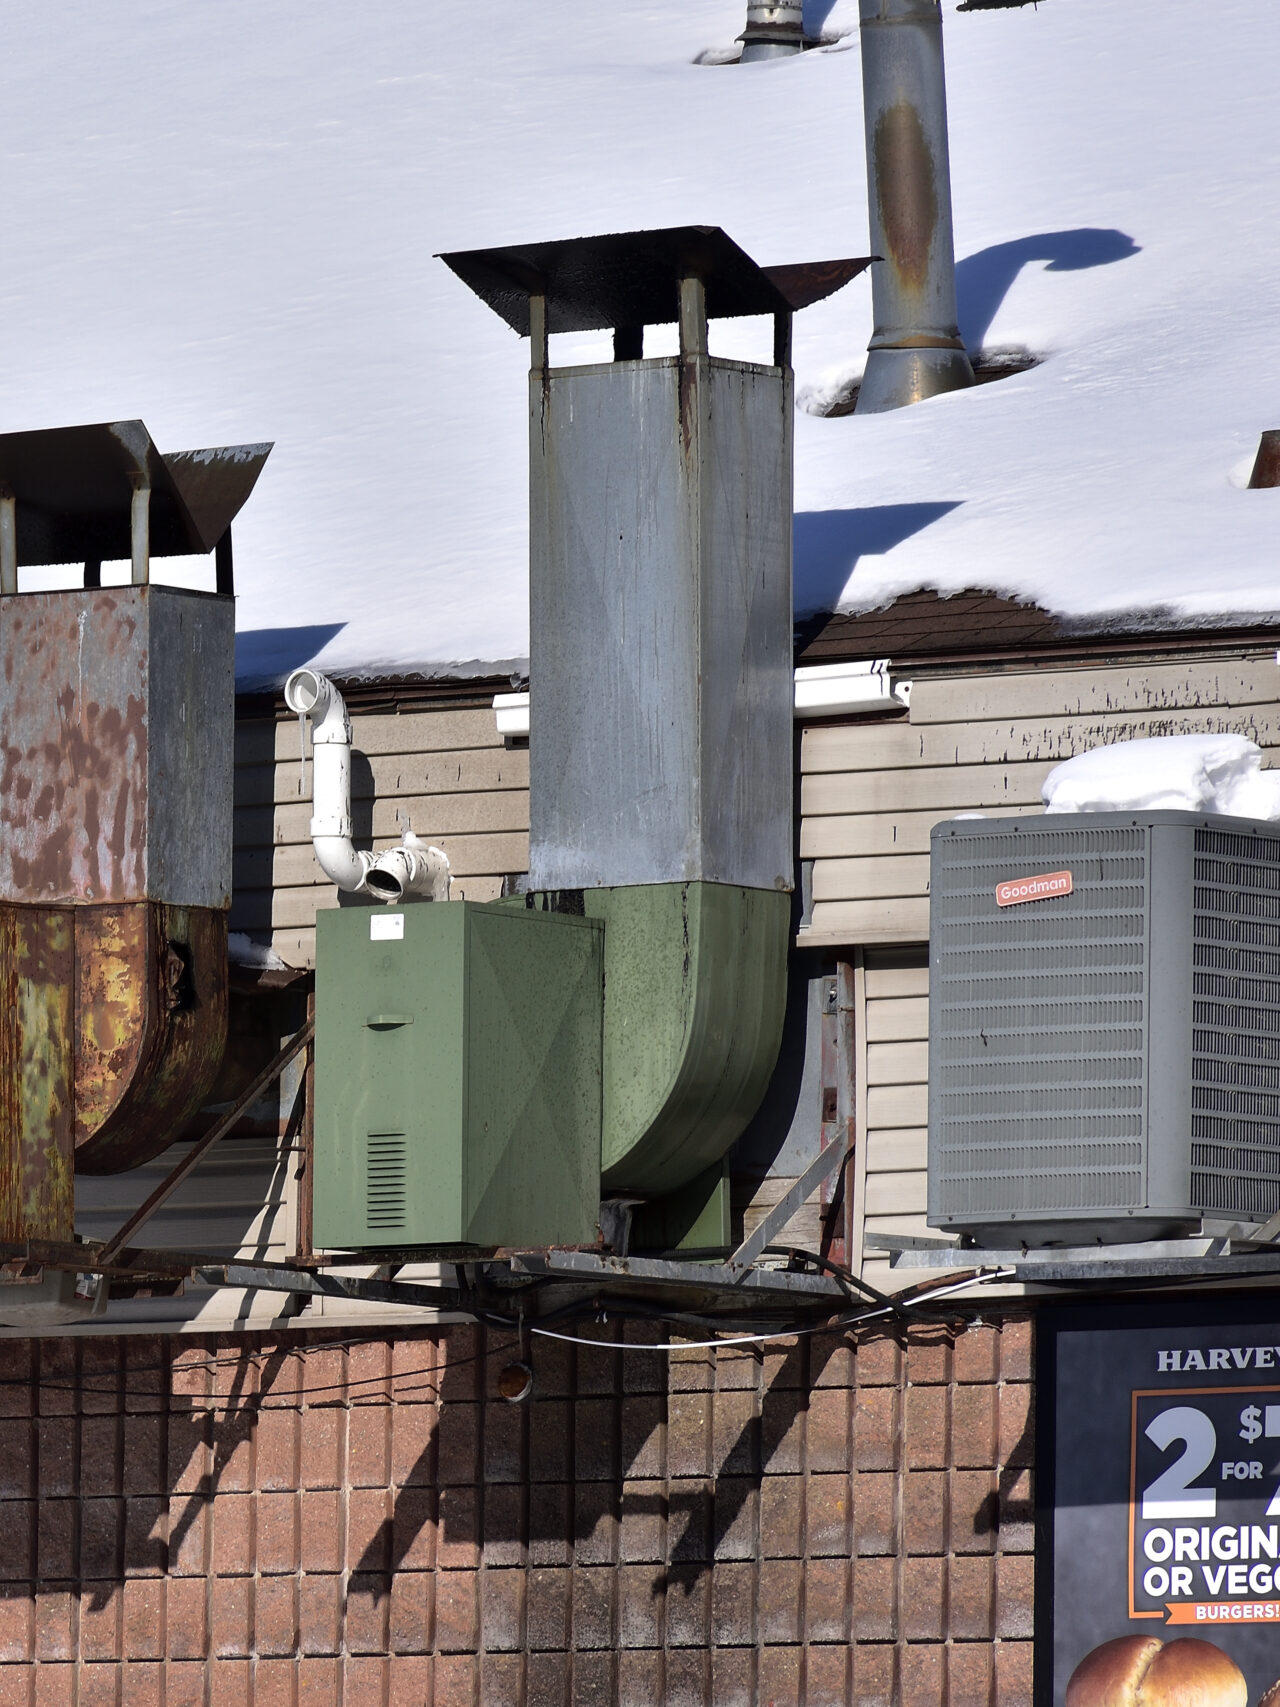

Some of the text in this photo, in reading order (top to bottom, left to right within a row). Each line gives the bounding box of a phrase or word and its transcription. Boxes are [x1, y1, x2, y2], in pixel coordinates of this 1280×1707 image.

[1000, 878, 1067, 899] Goodman
[1142, 1406, 1217, 1519] 2
[1222, 1461, 1264, 1480] FOR
[1143, 1525, 1280, 1562] ORIGIN
[1143, 1563, 1280, 1597] OR VEG
[1196, 1603, 1280, 1620] BURGERS!
